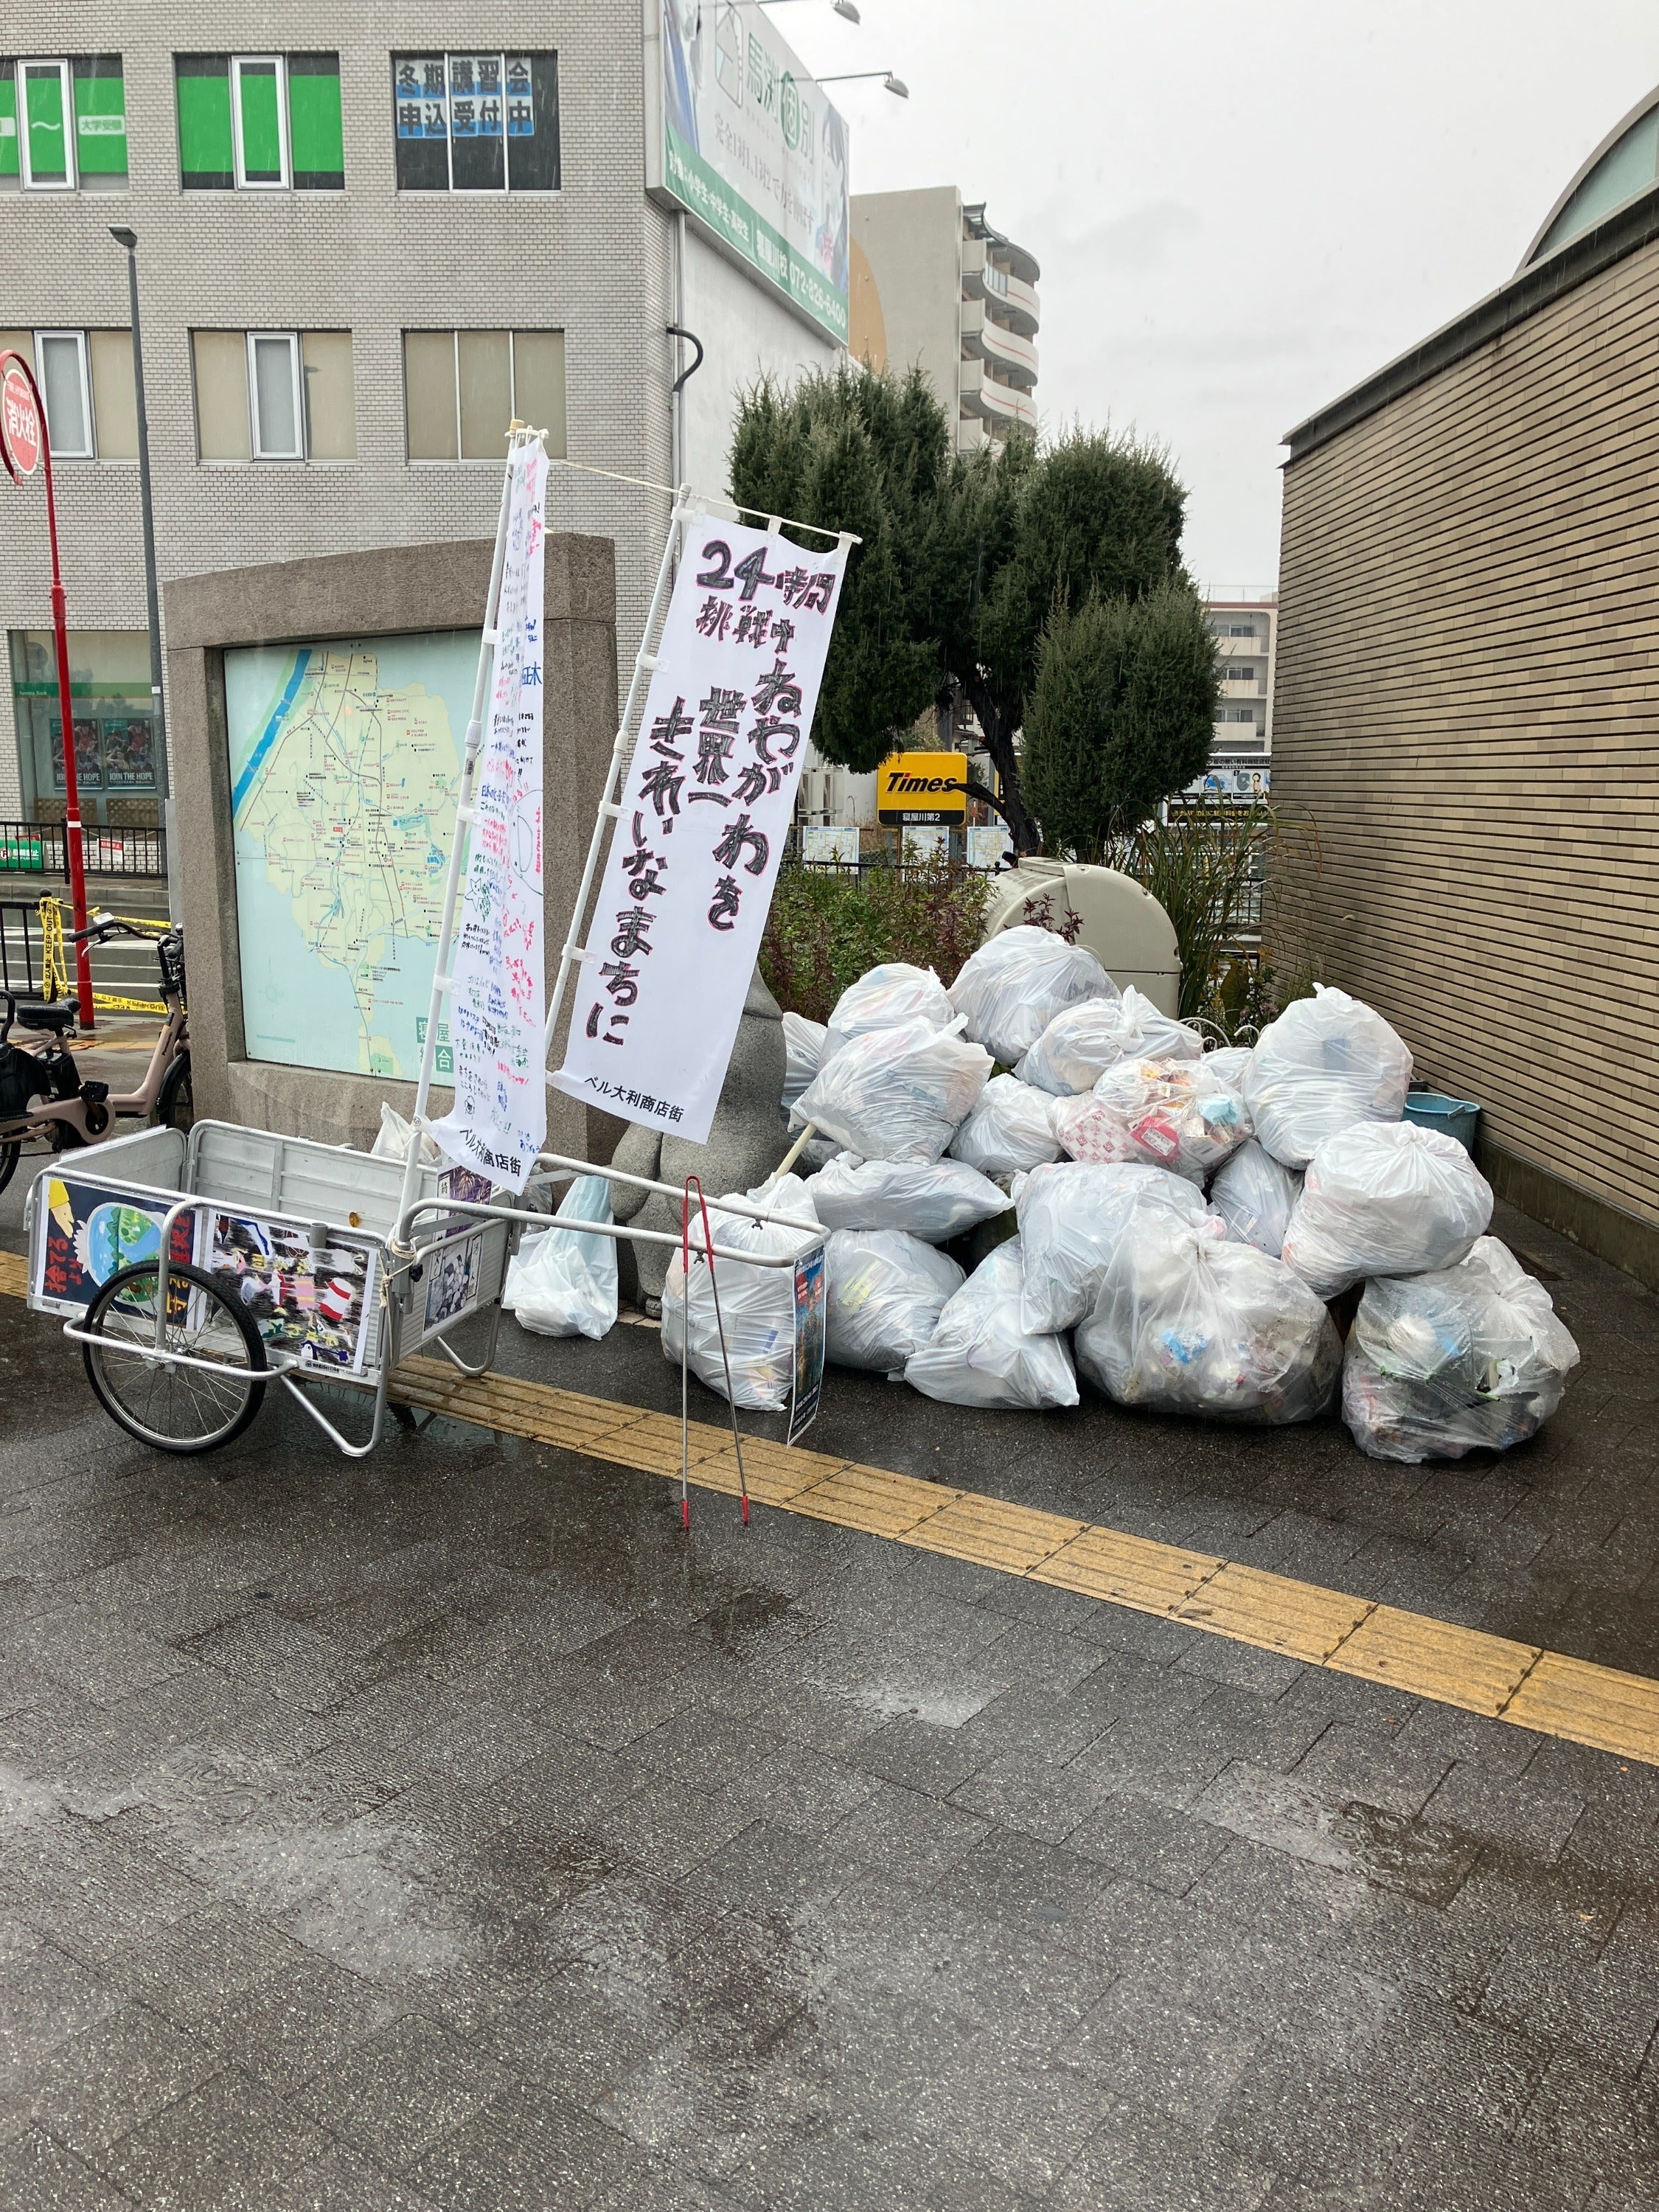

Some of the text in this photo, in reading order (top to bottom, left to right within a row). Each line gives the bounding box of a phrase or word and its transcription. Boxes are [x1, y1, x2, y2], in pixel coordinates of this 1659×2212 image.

[399, 60, 528, 94] 冬期講習会
[399, 100, 531, 134] 申込受付中
[6, 397, 36, 447] 消火栓
[696, 595, 796, 654] 挑戦中
[687, 685, 746, 810] 世界一
[83, 773, 100, 781] HOPE
[109, 772, 153, 781] JOIN THE HOPE
[886, 773, 957, 793] Times
[902, 813, 941, 821] 寝屋川第2
[585, 695, 696, 1047] きれいなまちに
[584, 1075, 685, 1124] ベル大利商店街
[44, 1235, 68, 1293] 捨てる
